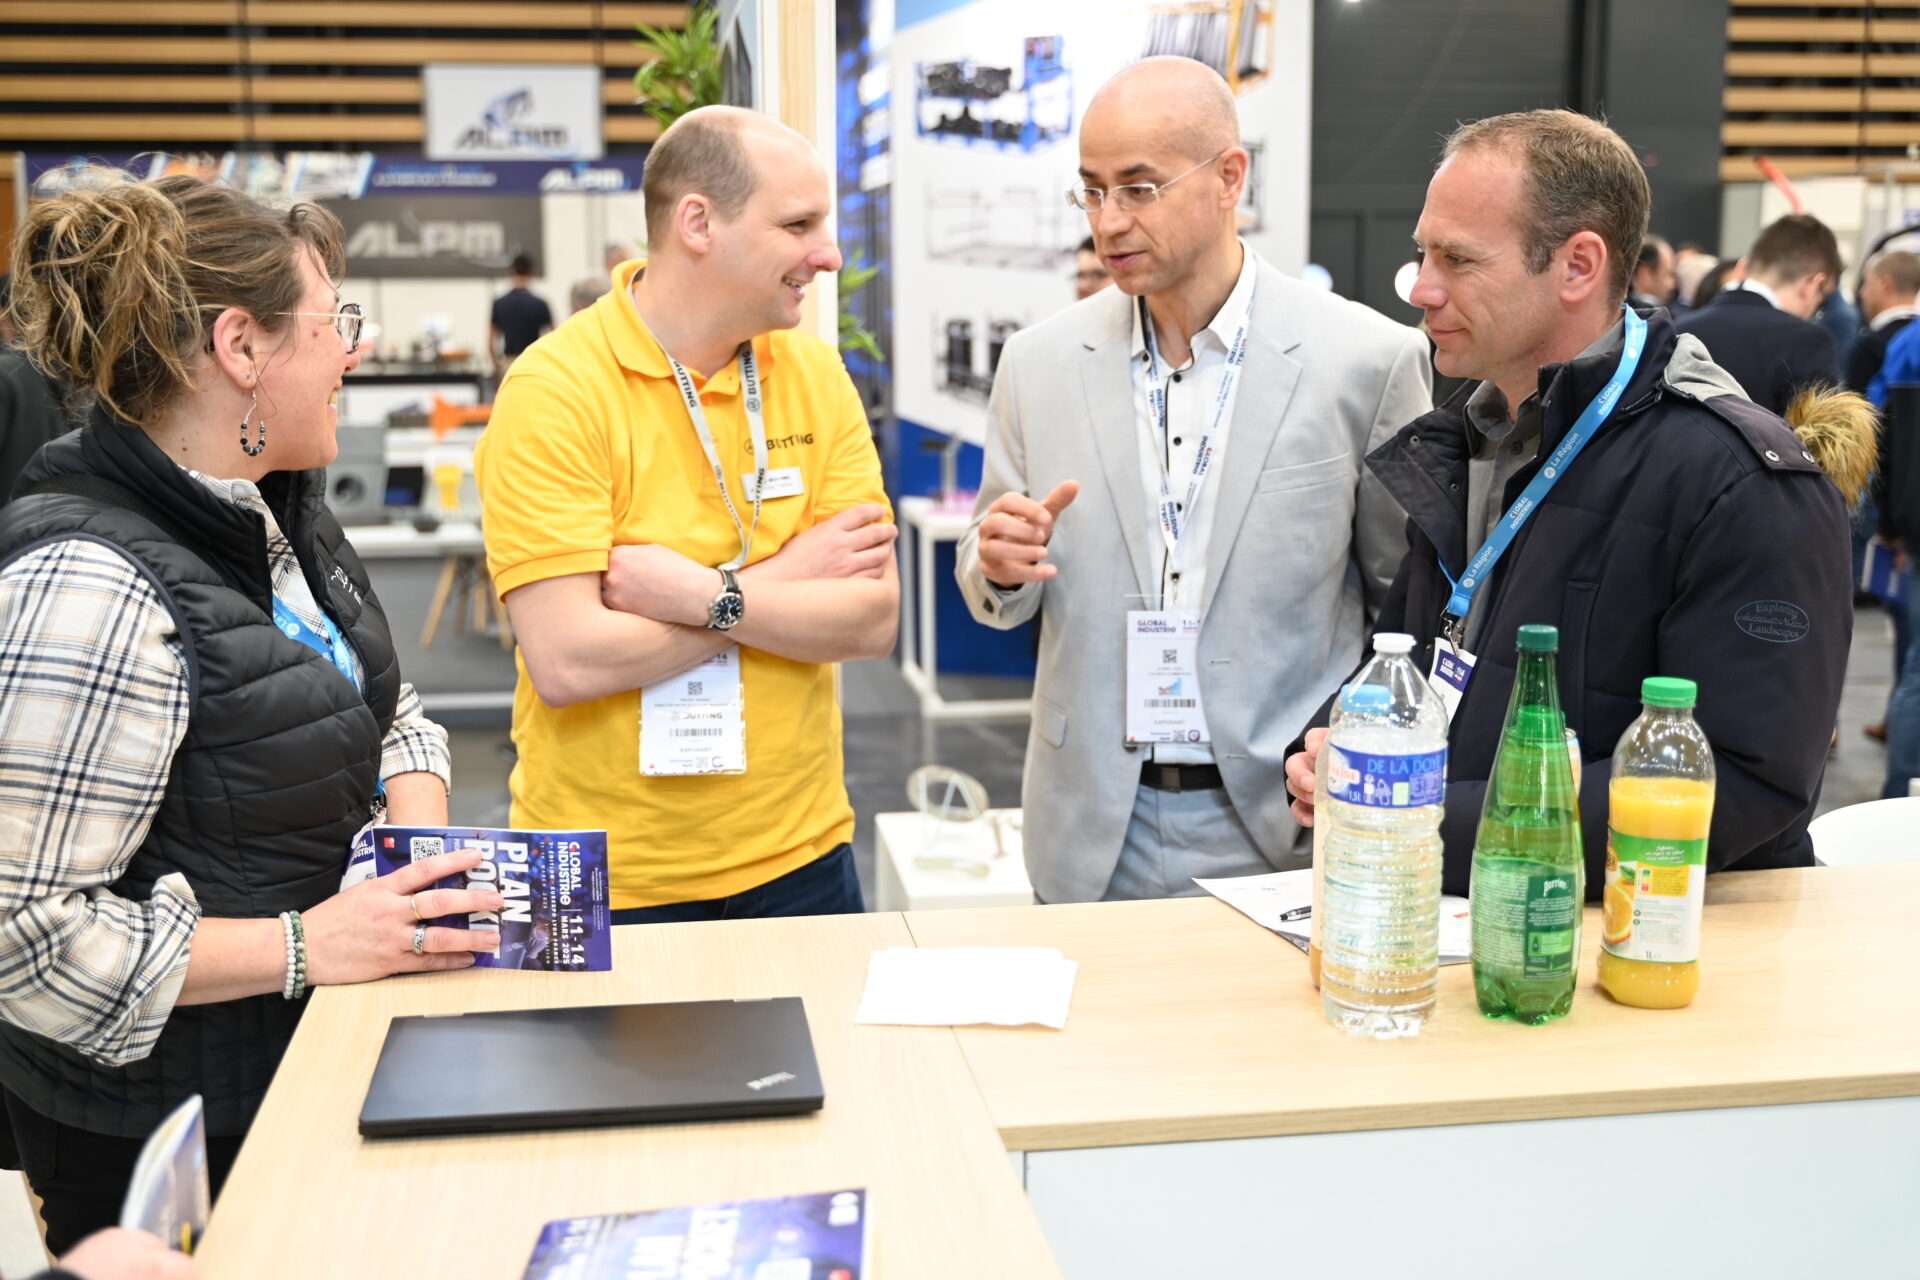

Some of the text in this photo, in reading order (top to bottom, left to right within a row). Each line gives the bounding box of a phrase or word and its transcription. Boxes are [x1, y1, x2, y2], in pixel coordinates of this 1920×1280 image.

[742, 350, 757, 395] BUTTING
[1367, 758, 1385, 774] DE
[1389, 758, 1409, 774] LA
[497, 841, 532, 923] PLAN
[568, 841, 581, 891] GLOBAL
[561, 915, 569, 939] MARS
[561, 942, 570, 965] 2025
